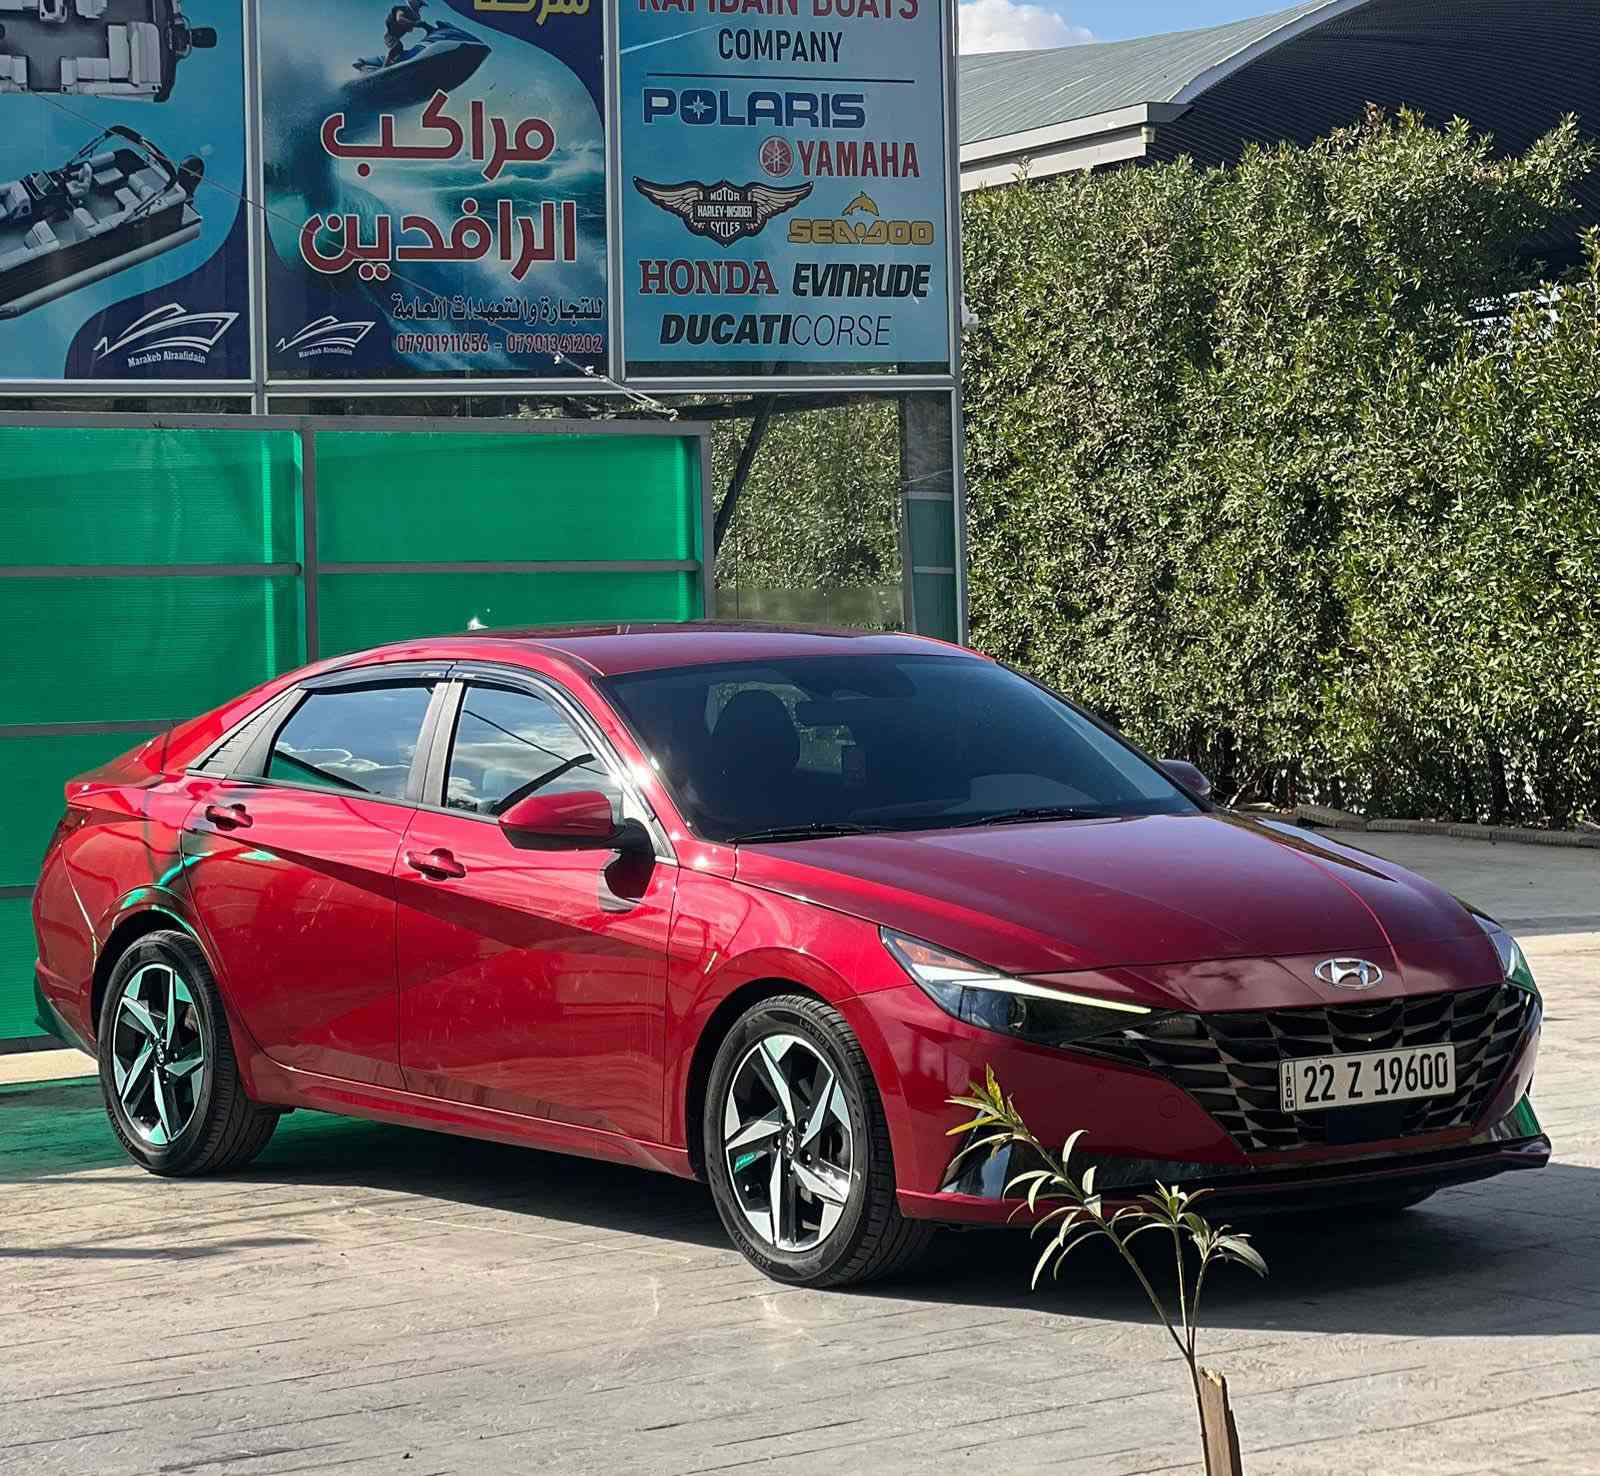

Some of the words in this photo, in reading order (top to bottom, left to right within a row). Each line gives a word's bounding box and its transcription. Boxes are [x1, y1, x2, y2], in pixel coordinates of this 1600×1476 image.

[718, 28, 843, 62] COMPANY
[643, 89, 867, 128] POLARIS
[320, 89, 556, 182] مراكب
[798, 141, 920, 178] YAMAHA
[710, 187, 740, 201] MOTOR
[300, 197, 577, 281] الرافدين
[710, 221, 741, 238] CYCLES
[639, 260, 780, 296] HONDA
[792, 263, 931, 298] EVINRUDE
[391, 293, 448, 320] العامة
[451, 295, 539, 327] والتعهدات
[540, 296, 604, 327] للتجارة
[397, 332, 489, 353] 07901911656
[128, 352, 161, 368] Marakeb
[1304, 1064, 1336, 1103] 22
[1347, 1061, 1363, 1098] Z
[1374, 1051, 1449, 1096] 19600
